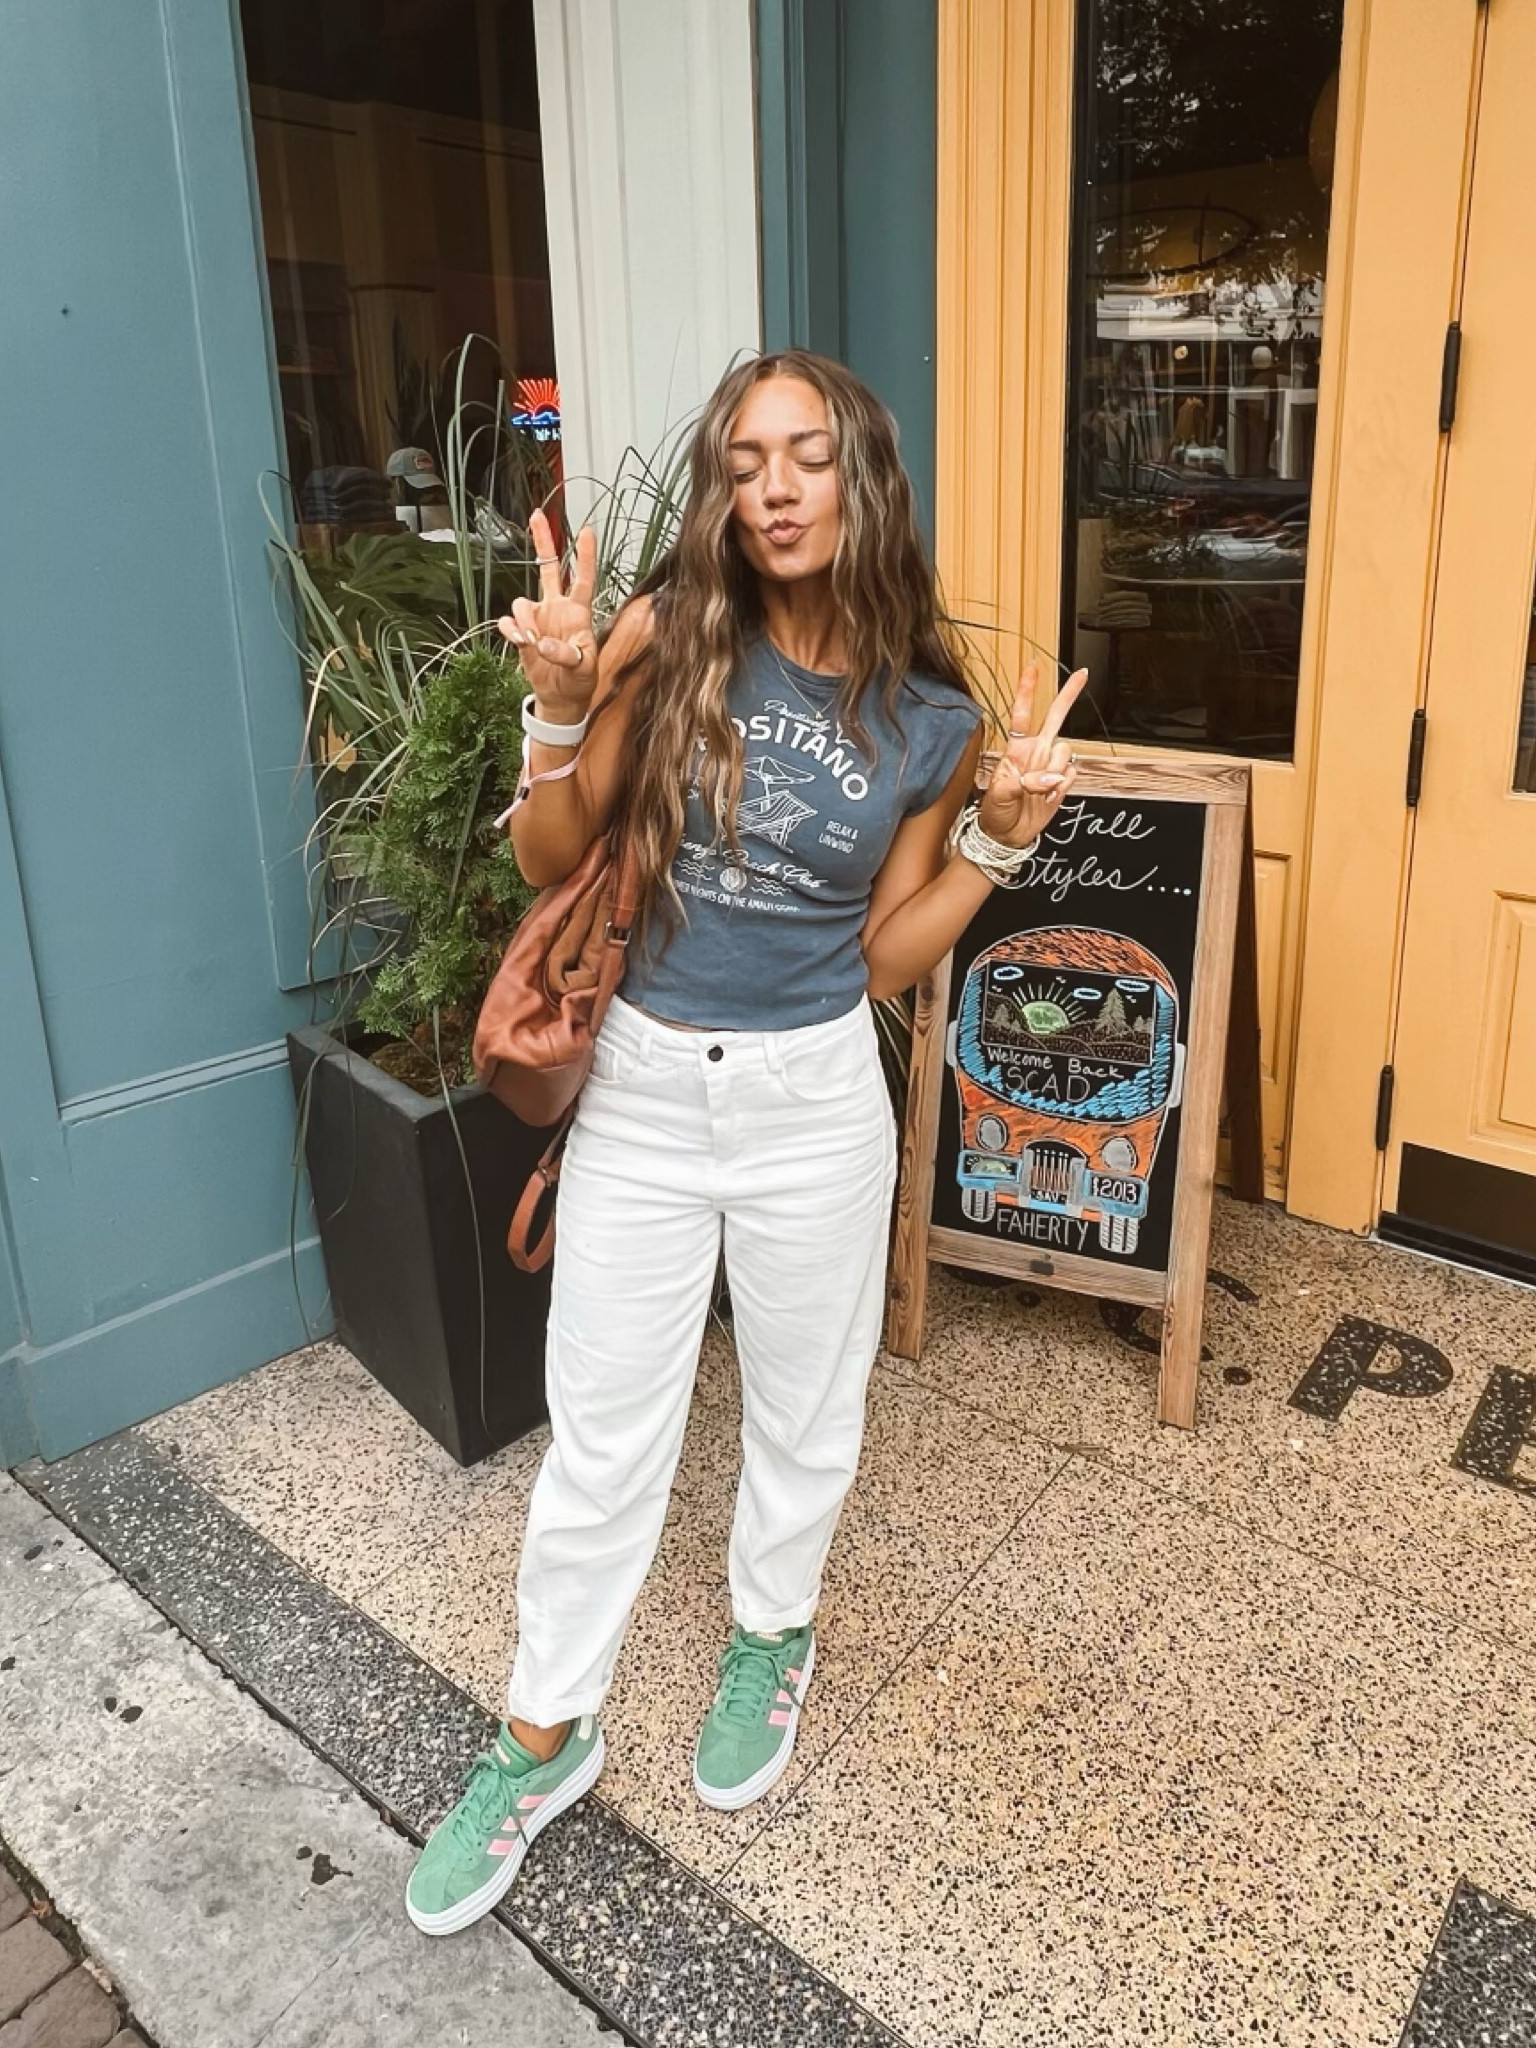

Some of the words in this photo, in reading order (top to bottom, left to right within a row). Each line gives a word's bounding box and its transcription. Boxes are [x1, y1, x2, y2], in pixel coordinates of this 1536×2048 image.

[697, 715, 869, 801] SITANO
[1045, 800, 1157, 844] Fall
[717, 892, 732, 906] ON
[987, 1046, 1053, 1069] Welcome
[1068, 1058, 1125, 1079] Back
[1005, 1067, 1091, 1103] SCAD
[1100, 1178, 1137, 1203] 2013
[996, 1208, 1089, 1251] FAHERTY
